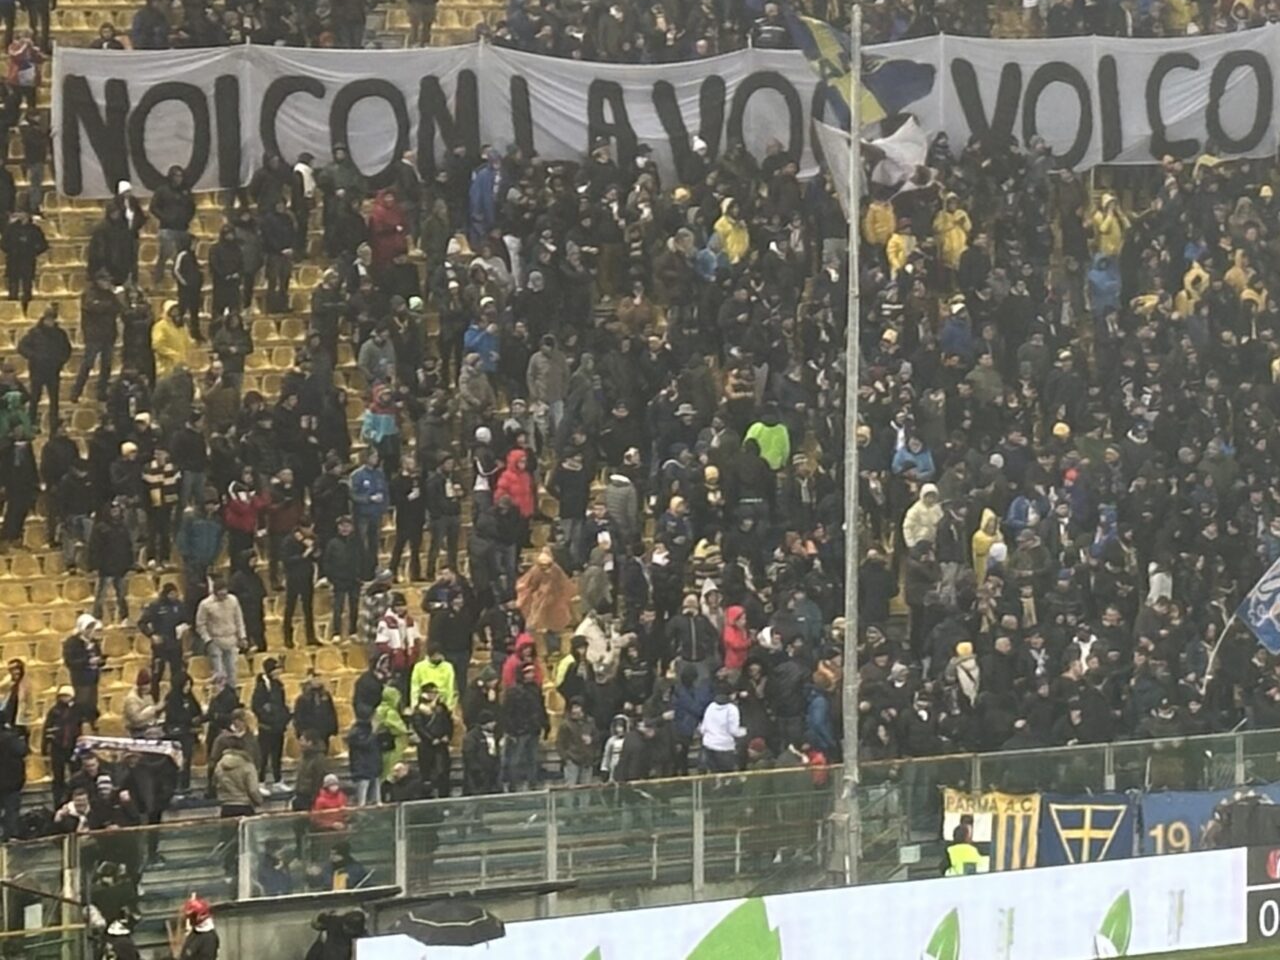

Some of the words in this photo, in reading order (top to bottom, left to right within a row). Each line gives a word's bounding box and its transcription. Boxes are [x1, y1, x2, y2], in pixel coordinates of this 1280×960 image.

[61, 72, 241, 197] NOI
[260, 69, 481, 181] CON
[950, 52, 1122, 171] VOI
[946, 793, 998, 815] PARMA
